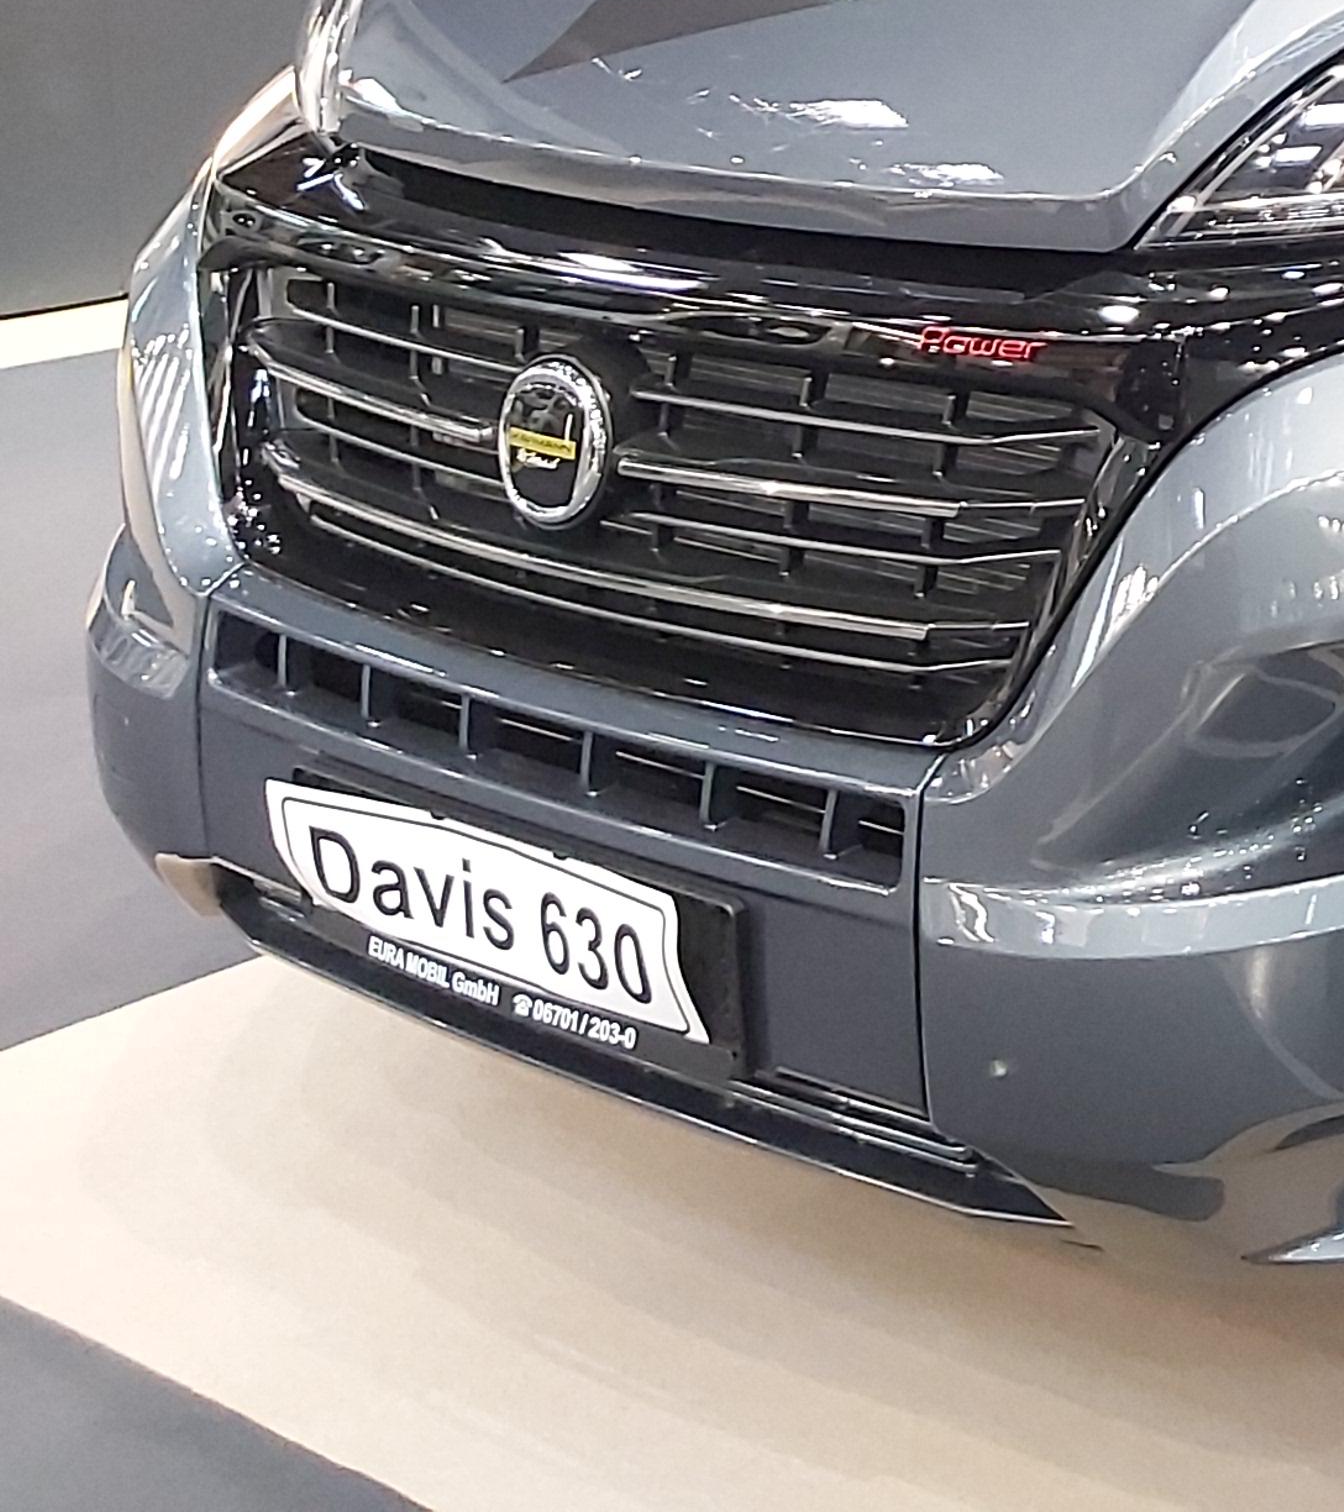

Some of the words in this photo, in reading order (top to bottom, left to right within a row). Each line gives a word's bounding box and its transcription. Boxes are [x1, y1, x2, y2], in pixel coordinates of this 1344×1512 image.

[919, 325, 1047, 358] Power
[309, 825, 515, 950] Davis
[541, 892, 652, 1004] 630
[368, 935, 405, 970] EURA
[405, 952, 450, 988] MOBIL
[452, 971, 500, 1006] GmbH
